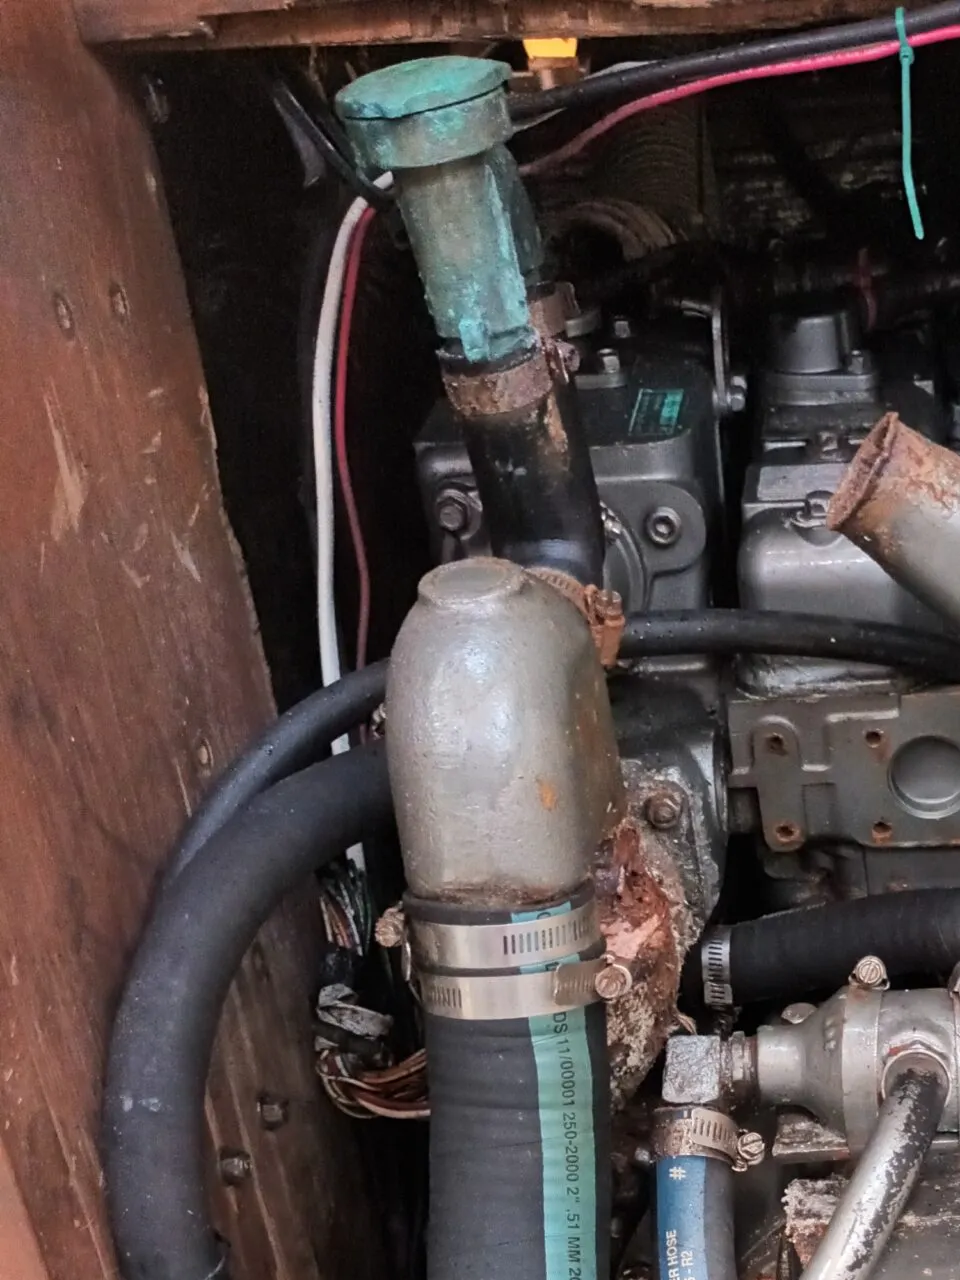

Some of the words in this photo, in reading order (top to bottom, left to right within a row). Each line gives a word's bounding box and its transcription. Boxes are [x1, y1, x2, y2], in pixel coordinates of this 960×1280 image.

[556, 1036, 575, 1107] 11/00001
[562, 1112, 580, 1182] 250-2000
[567, 1237, 581, 1263] MM
[666, 1230, 678, 1266] HOSE
[681, 1250, 694, 1267] R2
